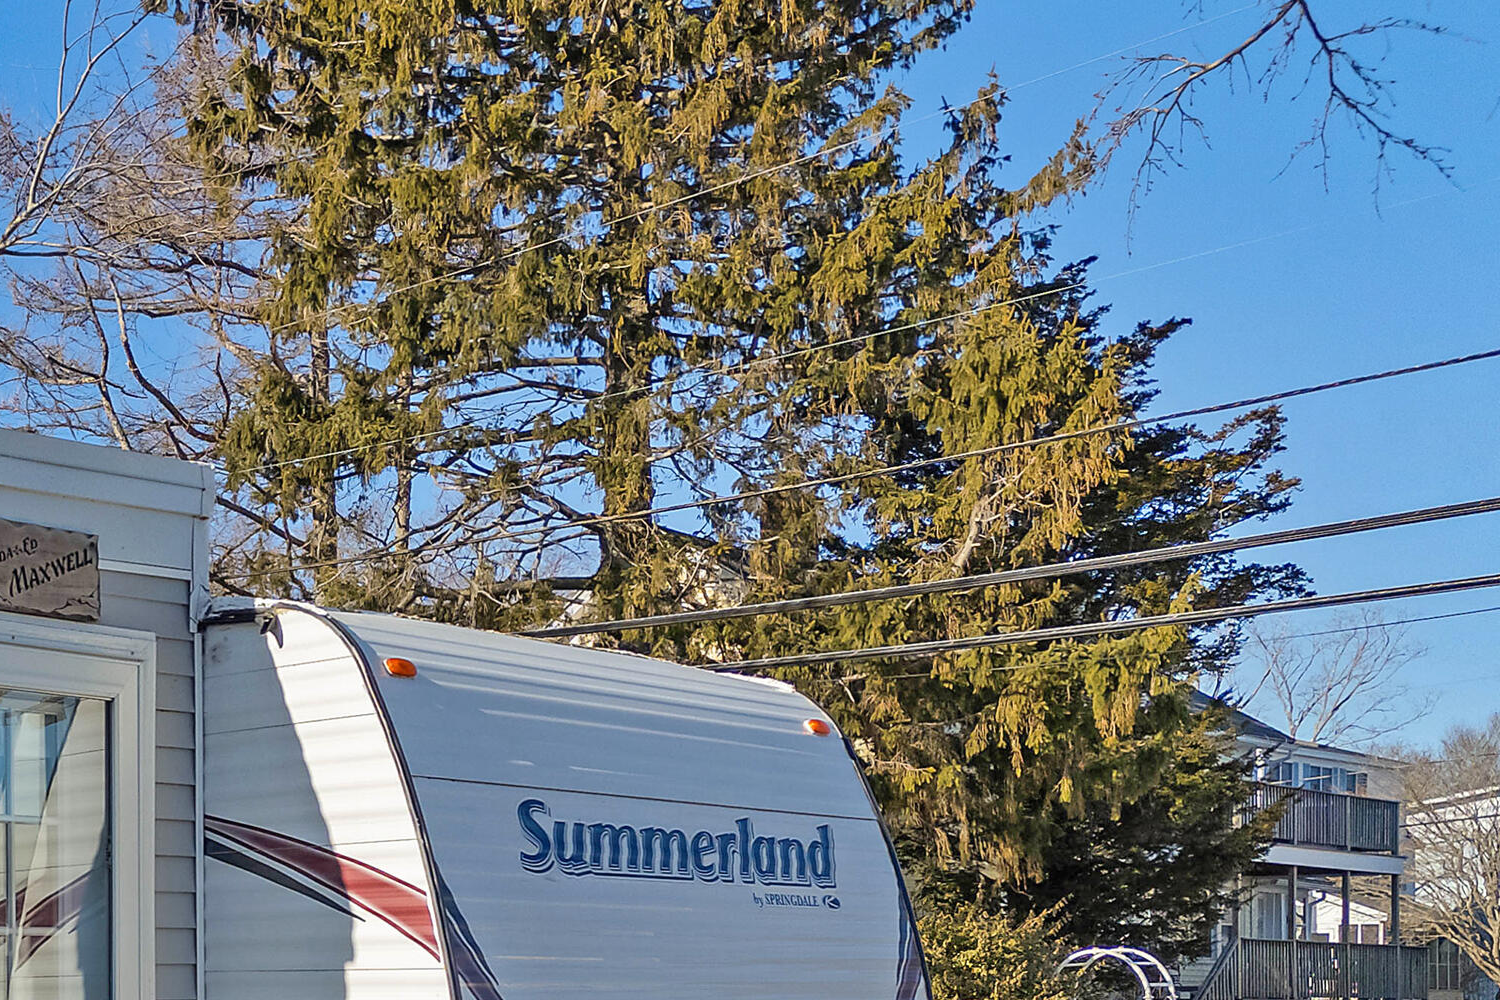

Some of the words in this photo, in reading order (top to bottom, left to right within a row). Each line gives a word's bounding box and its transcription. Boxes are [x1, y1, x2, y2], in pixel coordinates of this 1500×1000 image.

[22, 536, 38, 555] ED
[9, 548, 93, 597] MAXWELL
[517, 798, 837, 888] Summerland
[752, 892, 764, 908] by
[764, 893, 819, 907] SPRINGDALE
